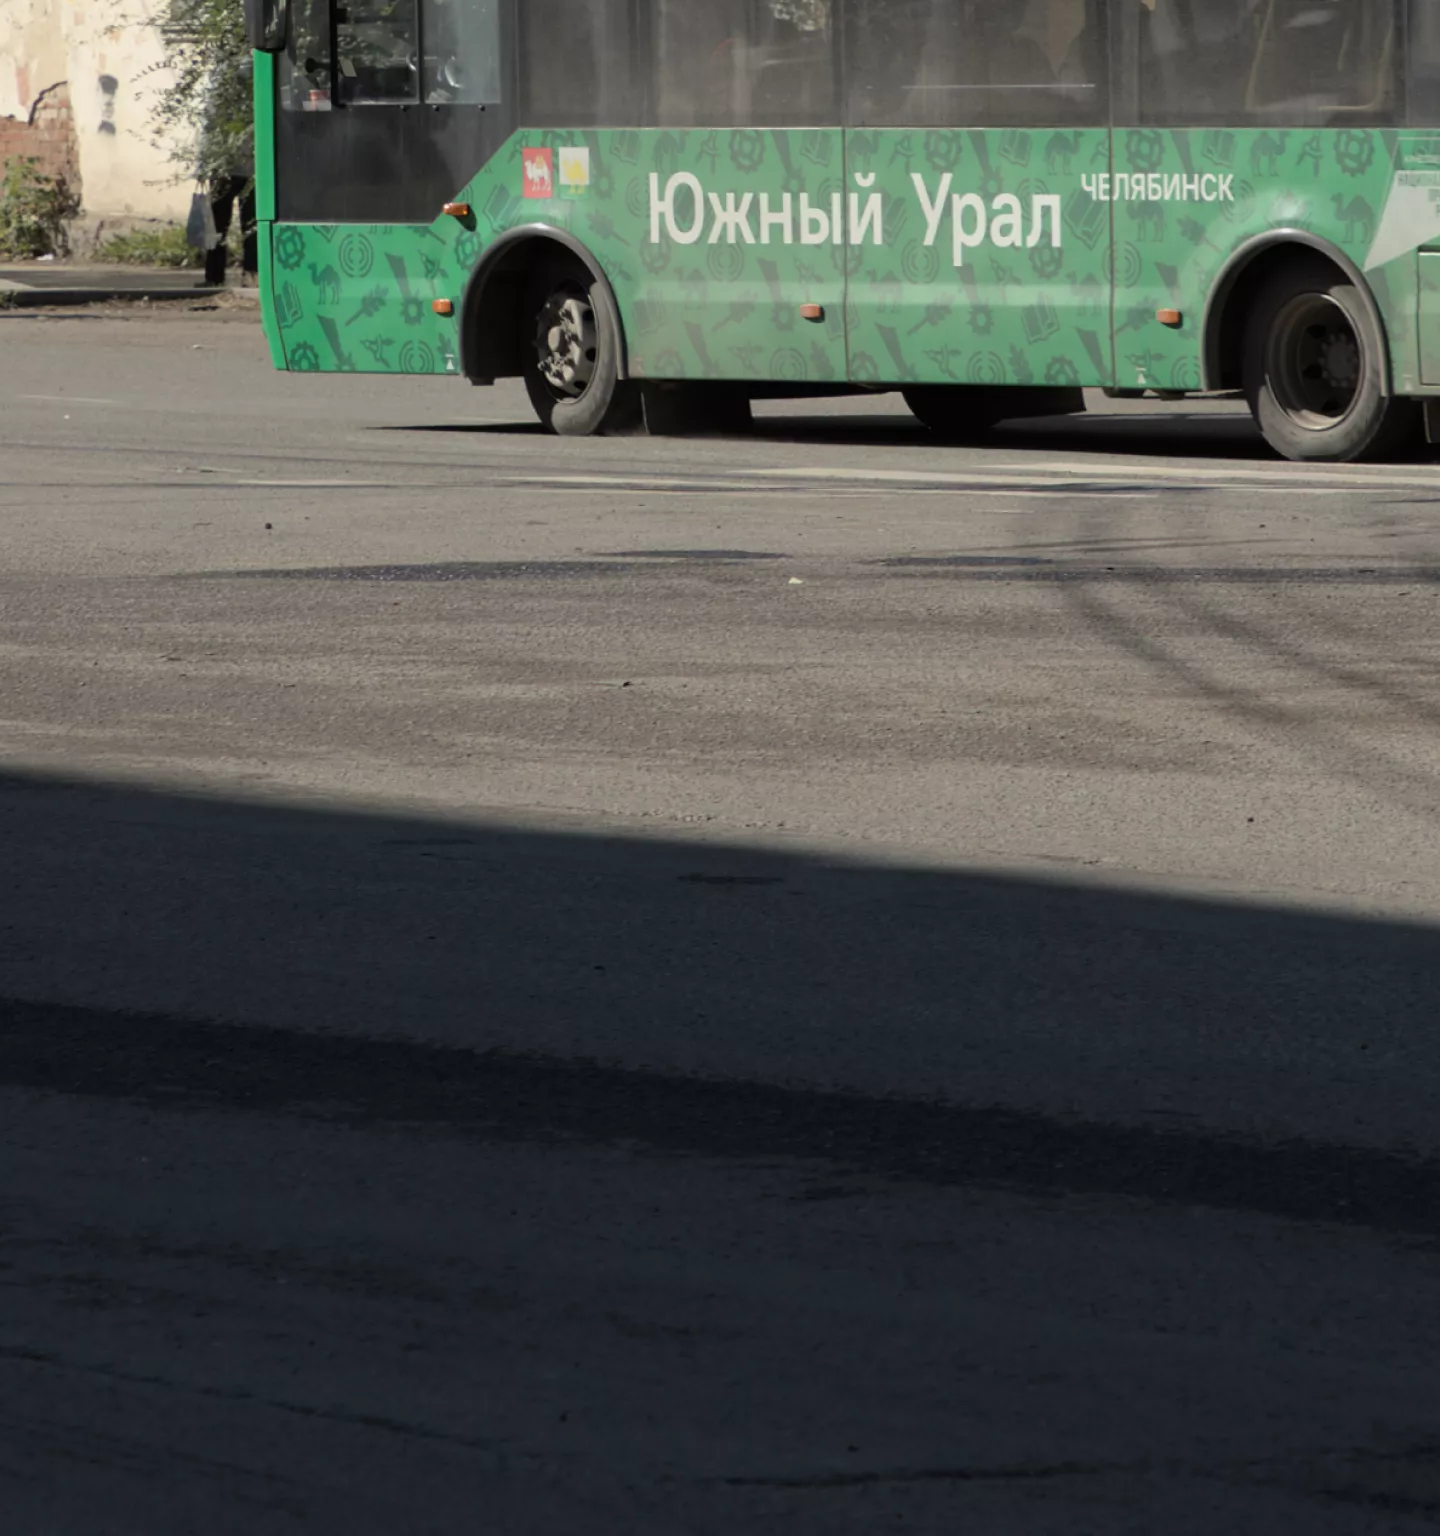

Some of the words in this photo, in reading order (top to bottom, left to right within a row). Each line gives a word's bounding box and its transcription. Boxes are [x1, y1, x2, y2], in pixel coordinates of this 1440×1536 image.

[648, 170, 883, 245] Южный
[910, 172, 1062, 267] Урал
[1080, 172, 1235, 202] ЧЕЛЯБИНСК
